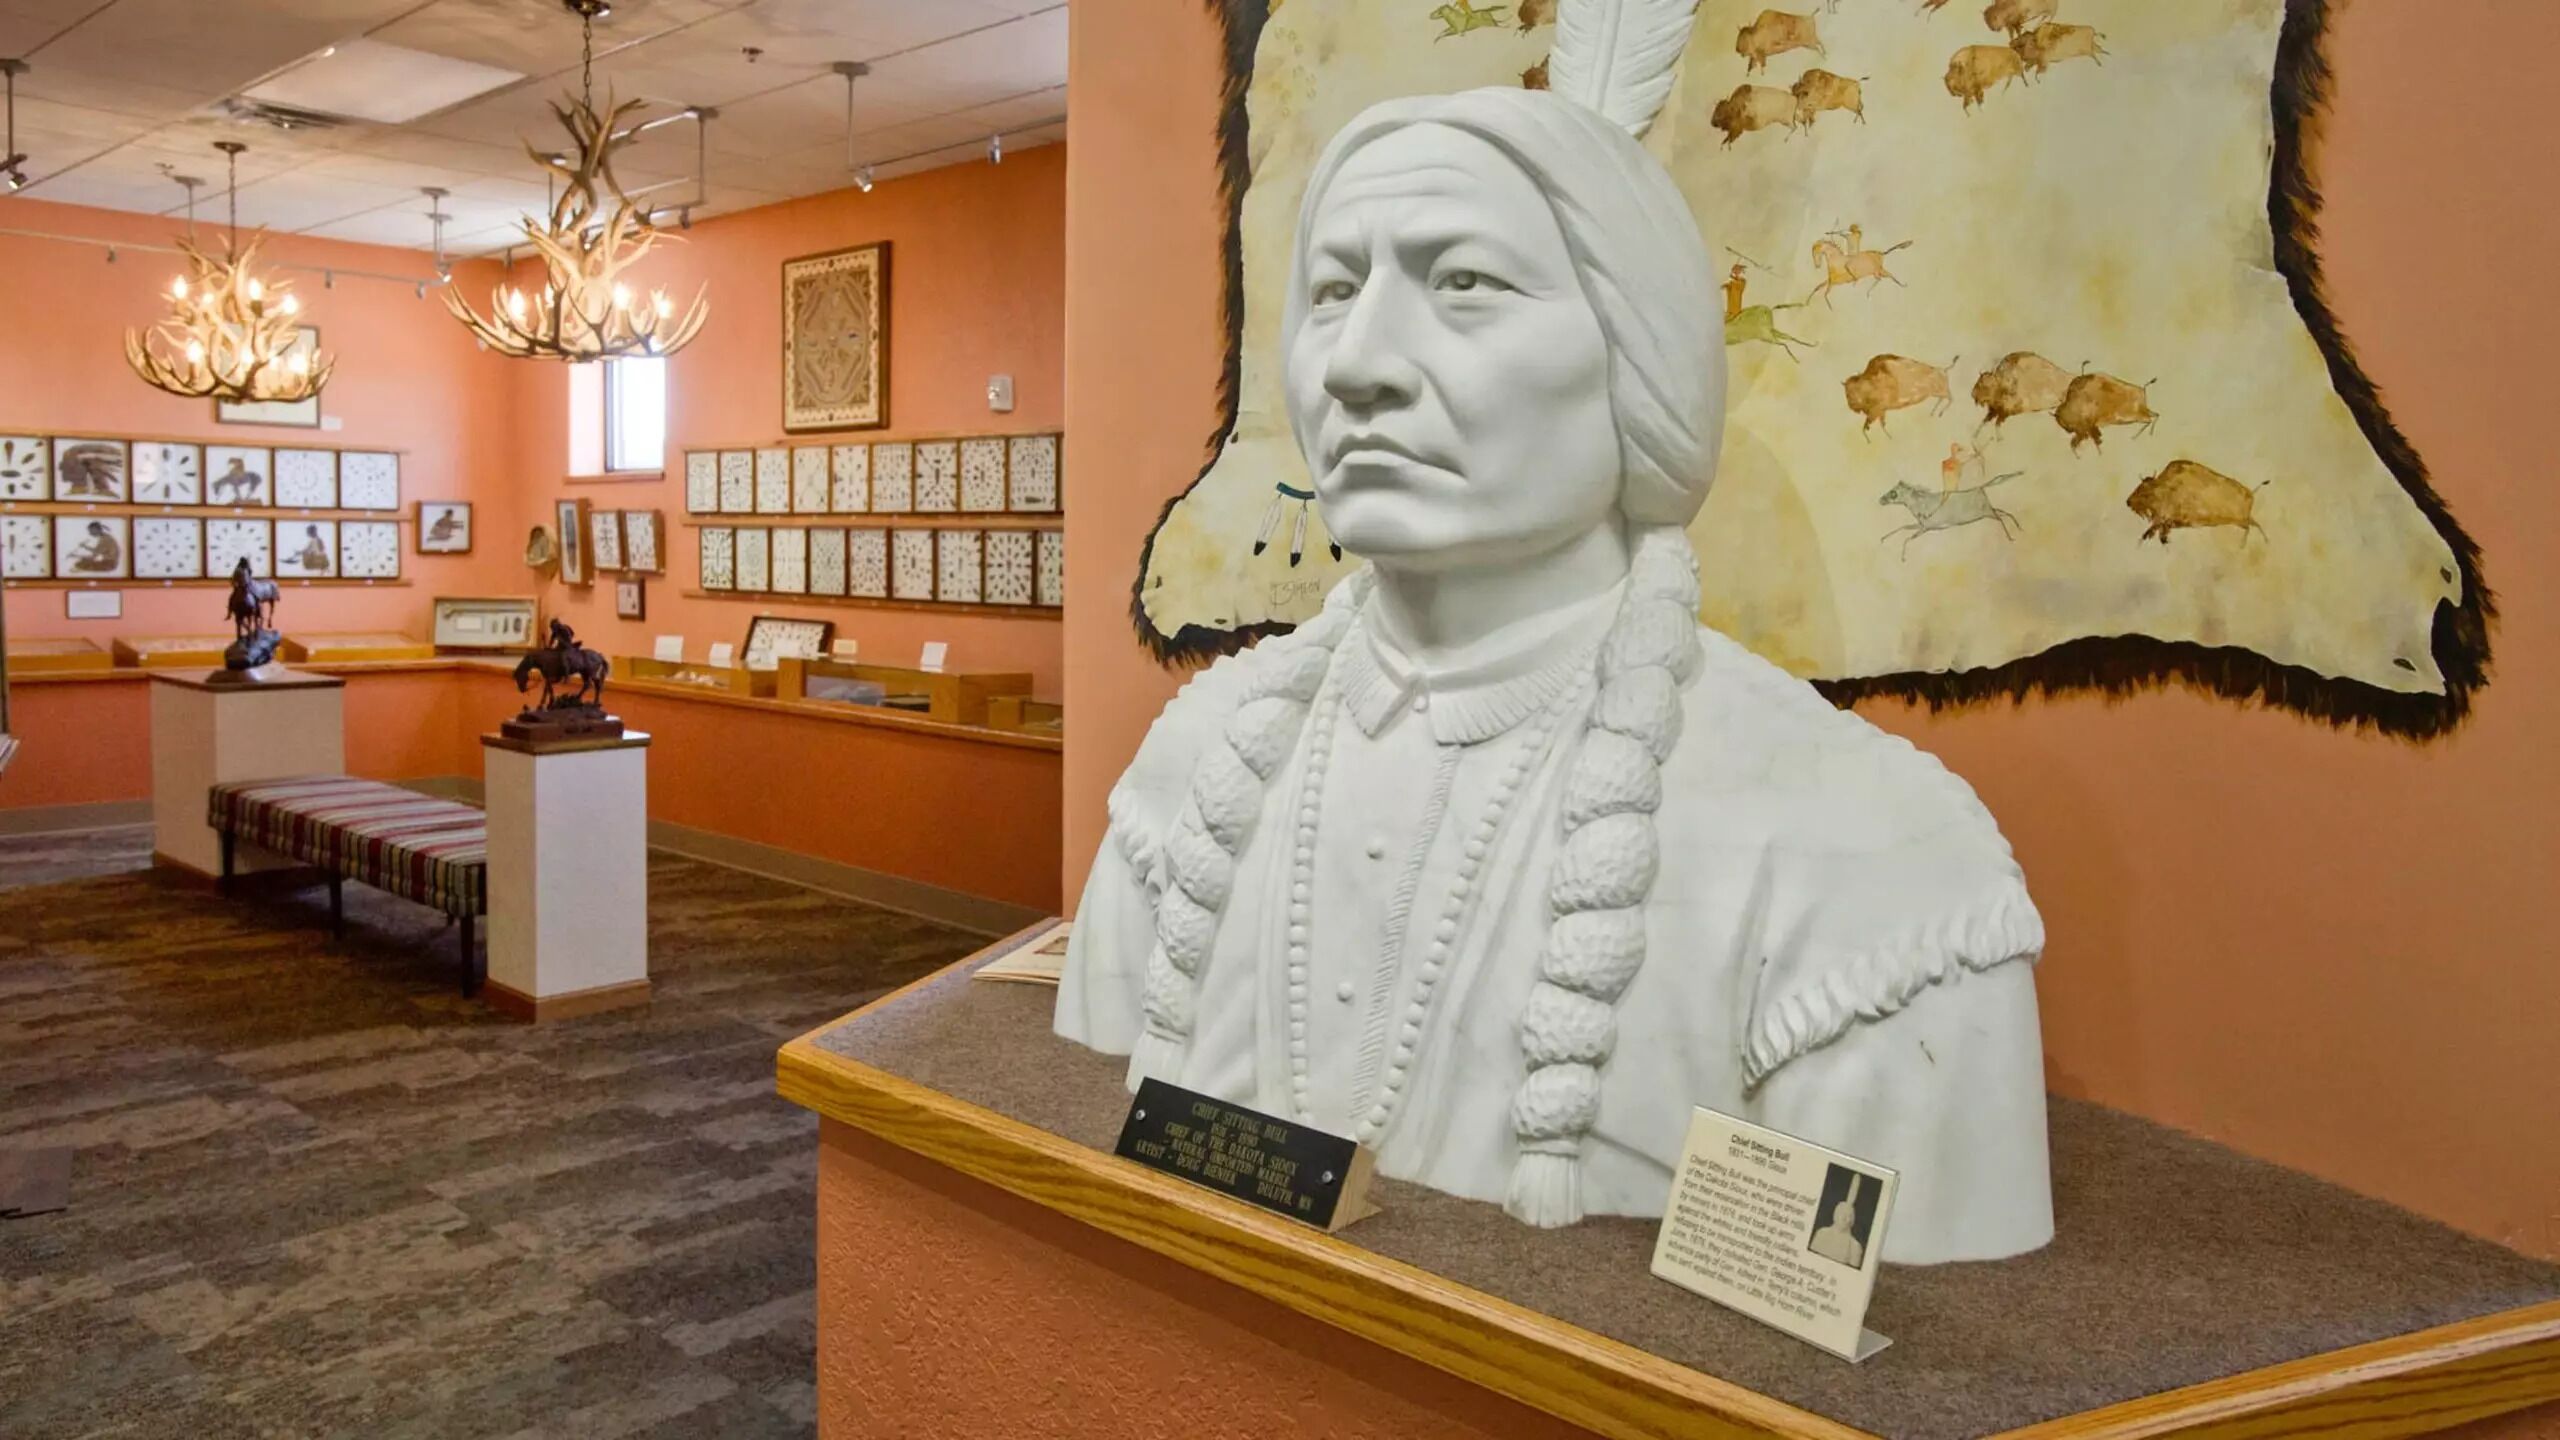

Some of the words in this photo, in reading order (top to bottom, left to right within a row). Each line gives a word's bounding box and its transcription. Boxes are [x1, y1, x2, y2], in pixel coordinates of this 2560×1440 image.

[1165, 1122, 1189, 1139] CHIEF
[1192, 1131, 1205, 1144] OF
[1209, 1137, 1225, 1151] THE
[1229, 1143, 1265, 1164] DAKOTA
[1191, 1102, 1219, 1121] CHIEF
[1223, 1112, 1260, 1134] SITTING
[1264, 1125, 1288, 1143] BULL
[1136, 1140, 1165, 1159] ARTIST
[1731, 1134, 1750, 1148] Chief
[1751, 1141, 1773, 1158] Sitting
[1775, 1149, 1790, 1162] Bull
[1257, 1168, 1289, 1187] MARBLE
[1687, 1167, 1695, 1176] of
[1694, 1169, 1704, 1179] the
[1705, 1173, 1728, 1188] Dakota
[1751, 1191, 1765, 1202] who
[1767, 1197, 1783, 1208] were
[1784, 1202, 1805, 1217] driven
[1690, 1154, 1707, 1167] Chief
[1708, 1161, 1727, 1177] Sitting
[1729, 1168, 1742, 1180] Bull
[1743, 1175, 1755, 1185] was
[1757, 1178, 1768, 1189] the
[1767, 1184, 1798, 1200] principal
[1798, 1195, 1816, 1207] chief
[1678, 1205, 1699, 1218] against
[1700, 1212, 1711, 1222] the
[1734, 1227, 1747, 1237] and
[1680, 1190, 1688, 1202] by
[1739, 1214, 1751, 1224] and
[1752, 1217, 1766, 1229] took
[1768, 1225, 1777, 1236] up
[1684, 1178, 1698, 1190] from
[1699, 1184, 1713, 1196] their
[1714, 1191, 1750, 1210] reservation
[1751, 1203, 1757, 1212] in
[1758, 1206, 1769, 1217] the
[1770, 1210, 1789, 1225] Black
[1675, 1217, 1699, 1233] refusing
[1700, 1225, 1705, 1234] to
[1707, 1228, 1716, 1238] be
[1755, 1247, 1761, 1256] to
[1762, 1250, 1773, 1261] the
[1668, 1240, 1693, 1256] advance
[1694, 1251, 1711, 1266] party
[1712, 1259, 1720, 1267] of
[1820, 1304, 1841, 1318] which
[1771, 1267, 1796, 1285] George
[1746, 1285, 1763, 1299] Little
[1764, 1293, 1775, 1307] Big
[1777, 1298, 1794, 1313] Horn
